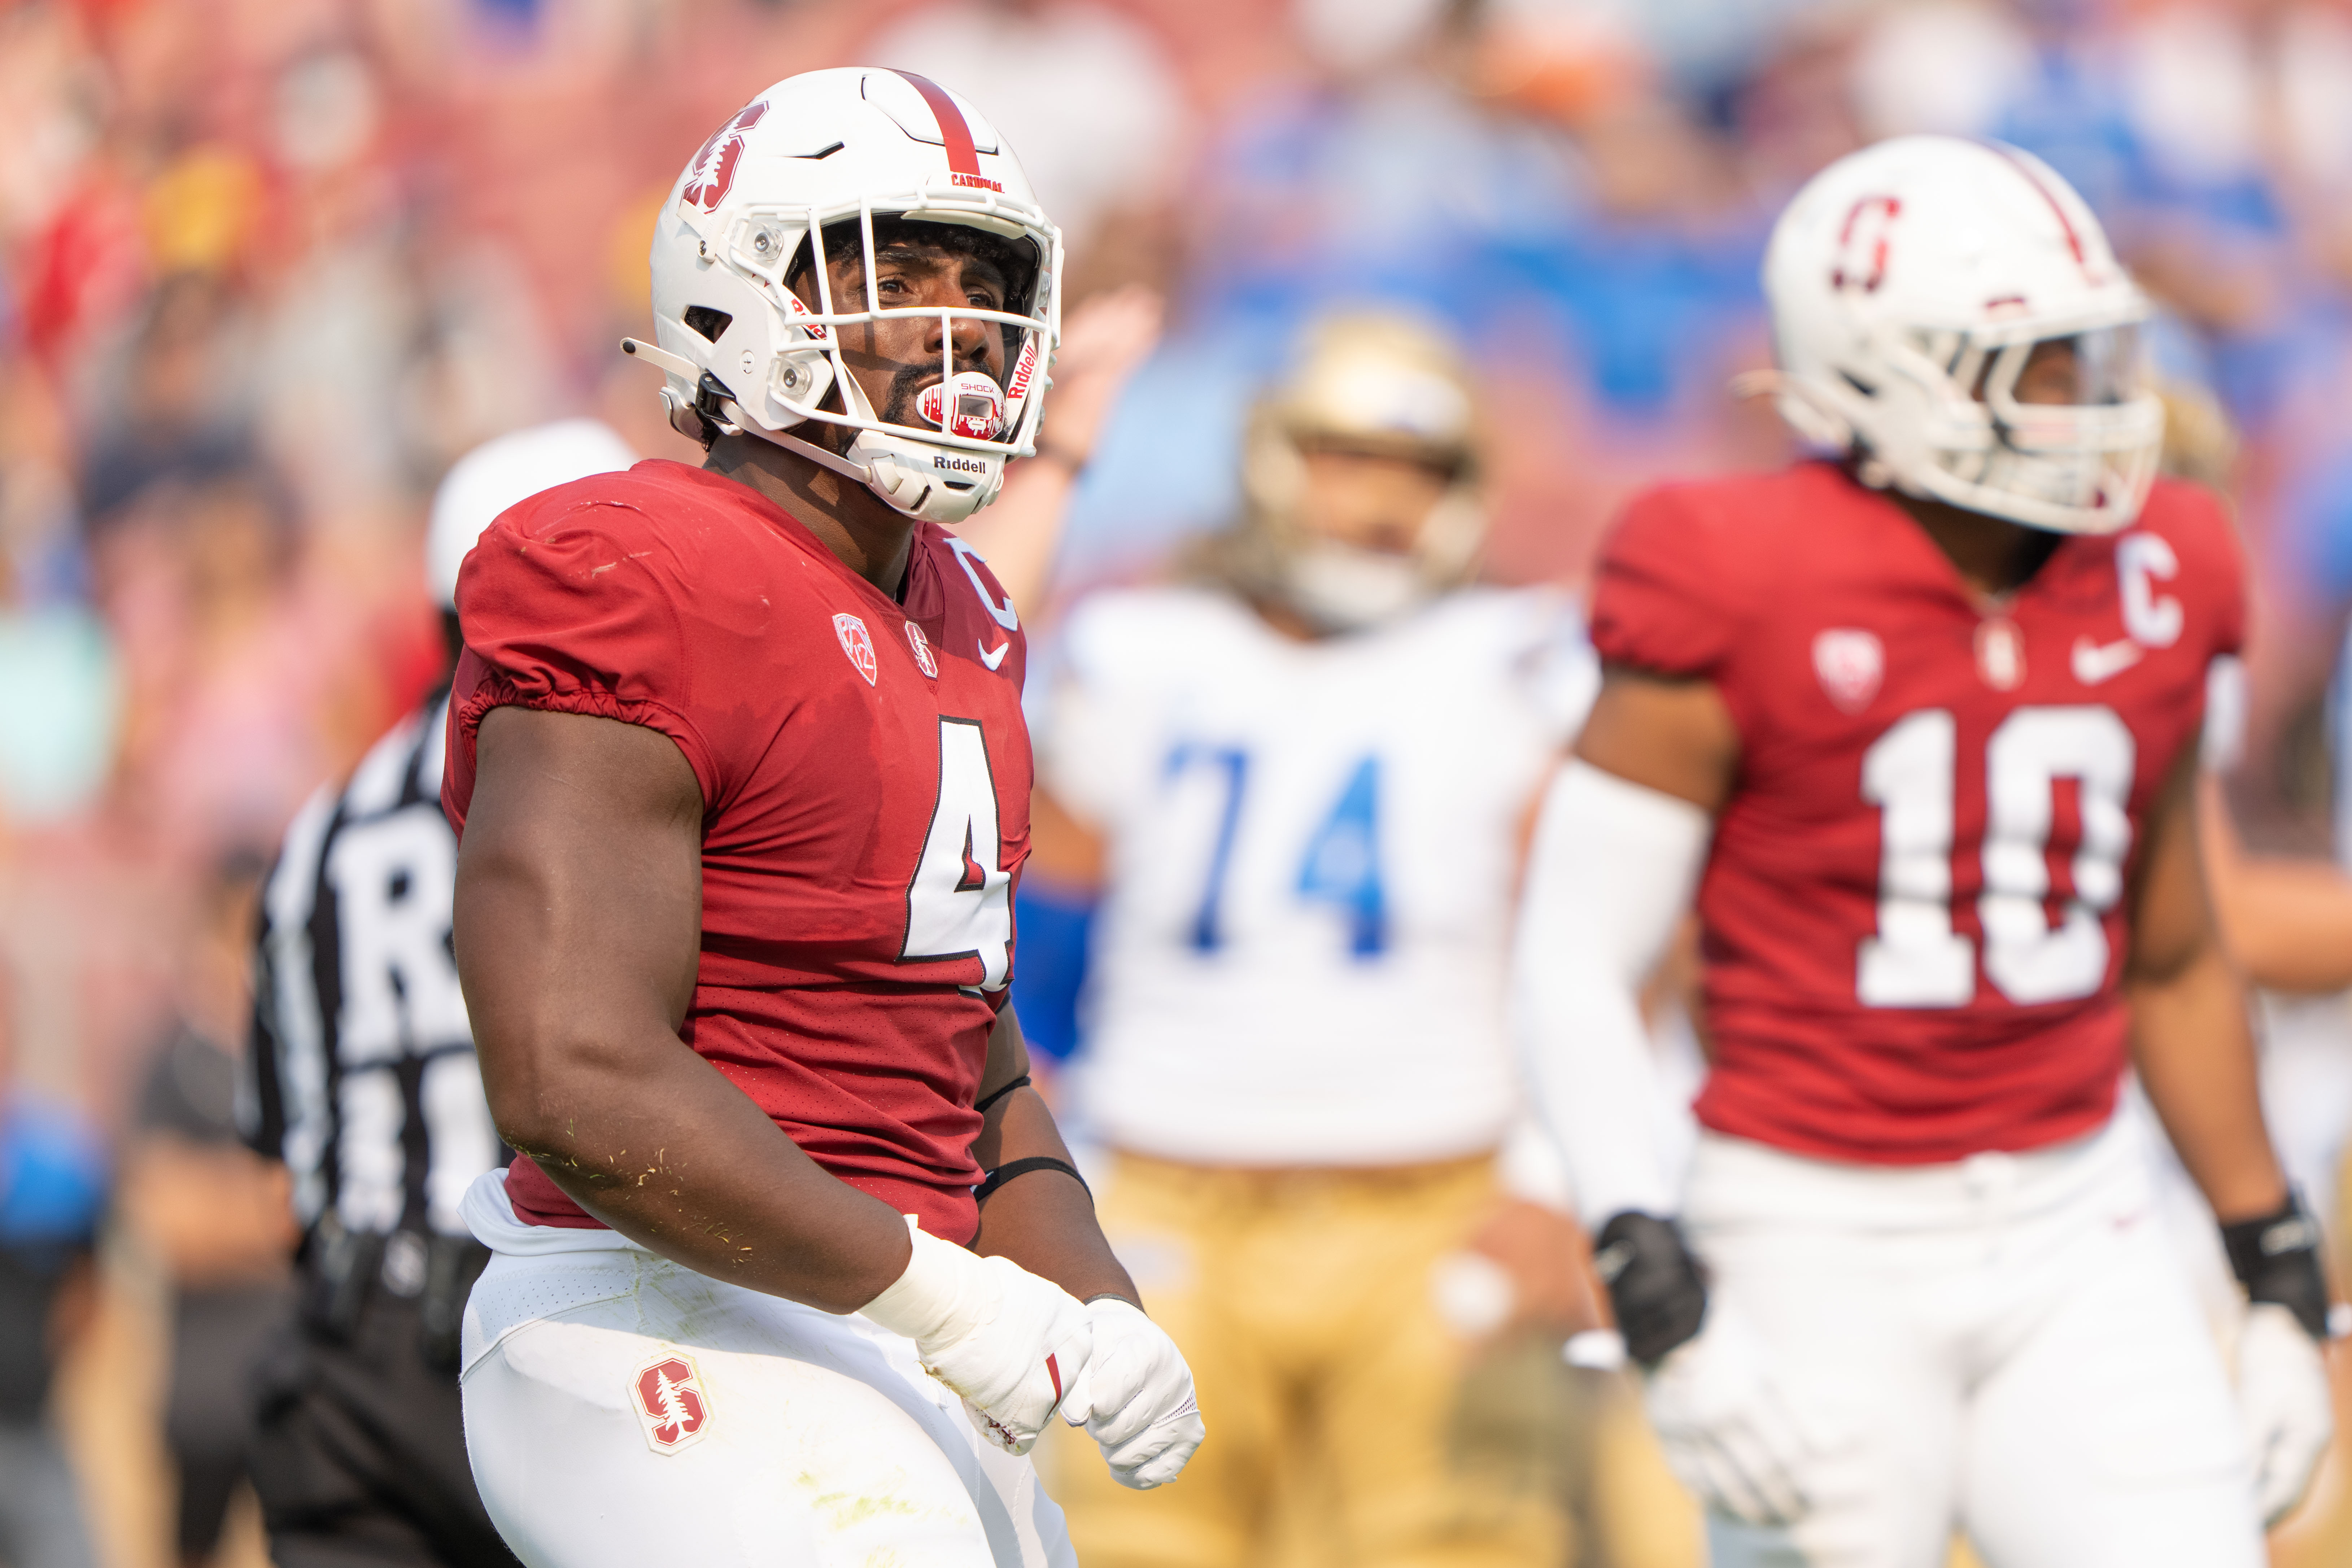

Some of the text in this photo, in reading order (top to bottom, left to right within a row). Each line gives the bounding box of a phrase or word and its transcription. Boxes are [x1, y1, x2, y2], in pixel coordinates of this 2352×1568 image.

[961, 383, 995, 394] SHOCK
[1007, 344, 1037, 399] Riddell
[934, 456, 986, 474] Riddell
[943, 537, 1018, 632] C
[2115, 530, 2184, 647] C
[854, 643, 874, 669] 12
[894, 714, 1015, 1002] 4
[1158, 742, 1389, 958] 74
[1855, 702, 2137, 1009] 10
[327, 803, 469, 1063] R
